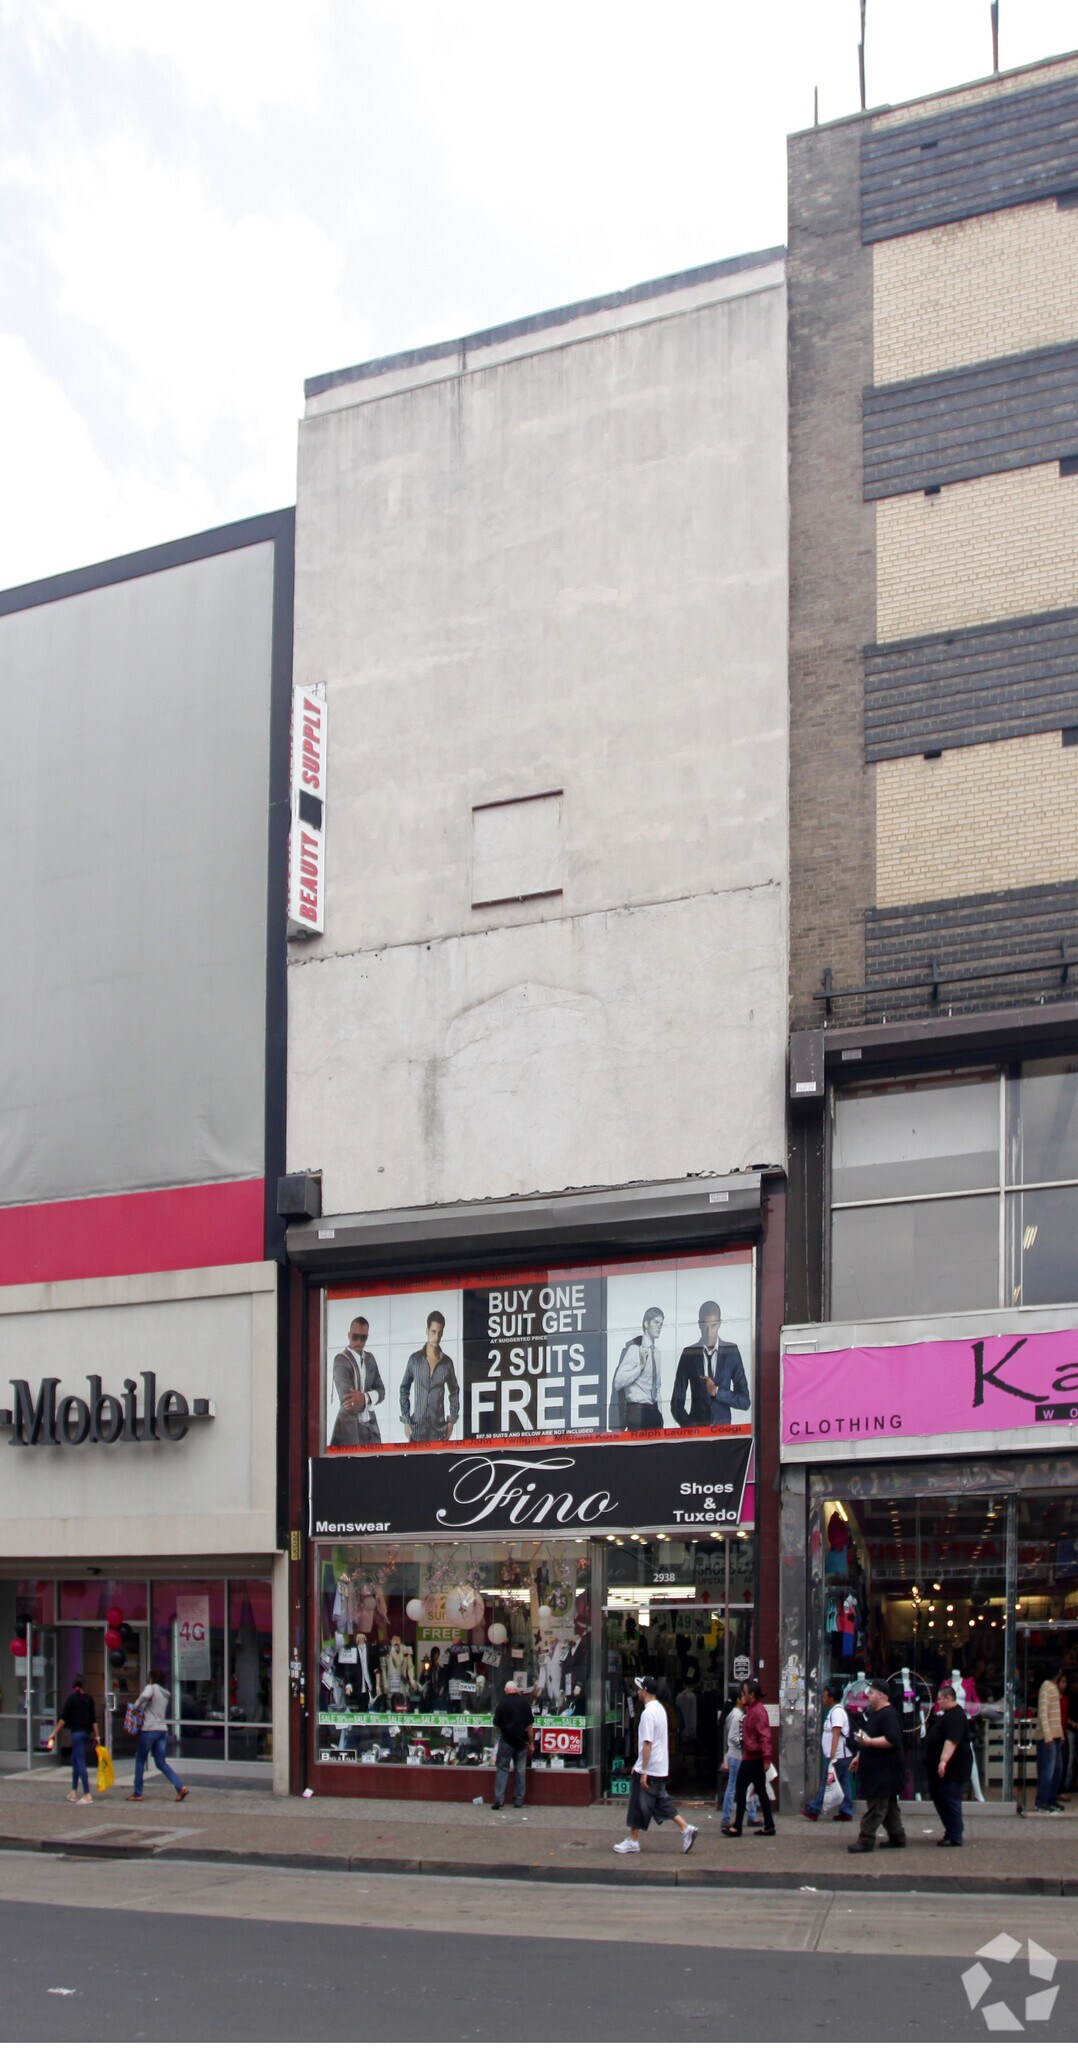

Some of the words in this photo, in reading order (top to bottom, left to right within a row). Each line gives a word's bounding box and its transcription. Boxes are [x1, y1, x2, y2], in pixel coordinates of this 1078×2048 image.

[301, 696, 321, 789] SUPPLY
[299, 830, 319, 922] BEAUTY
[488, 1288, 533, 1314] BUY
[538, 1285, 585, 1310] ONE
[487, 1313, 536, 1338] SUIT
[541, 1308, 587, 1334] GET
[487, 1349, 502, 1378] 2
[508, 1343, 585, 1376] SUITS
[7, 1370, 190, 1446] Mobile
[471, 1374, 600, 1434] FREE
[630, 1428, 661, 1439] Ralph
[664, 1427, 700, 1437] Lauren
[710, 1425, 741, 1434] Coogi
[789, 1414, 902, 1436] CLOTHING
[435, 1455, 619, 1528] Fino
[680, 1482, 734, 1496] Shoes
[703, 1497, 717, 1510] &
[672, 1509, 737, 1523] Tuxedo
[316, 1520, 391, 1533] Menswear
[652, 1573, 676, 1583] 2938
[179, 1621, 206, 1642] 4G
[422, 1628, 461, 1639] FREE
[320, 1714, 335, 1724] SALE
[354, 1715, 367, 1724] SALE
[388, 1716, 402, 1724] SALE
[421, 1716, 435, 1724] SALE
[456, 1716, 470, 1725] SALE
[562, 1718, 578, 1726] SALE
[543, 1732, 580, 1750] 50%
[614, 1782, 628, 1793] 19
